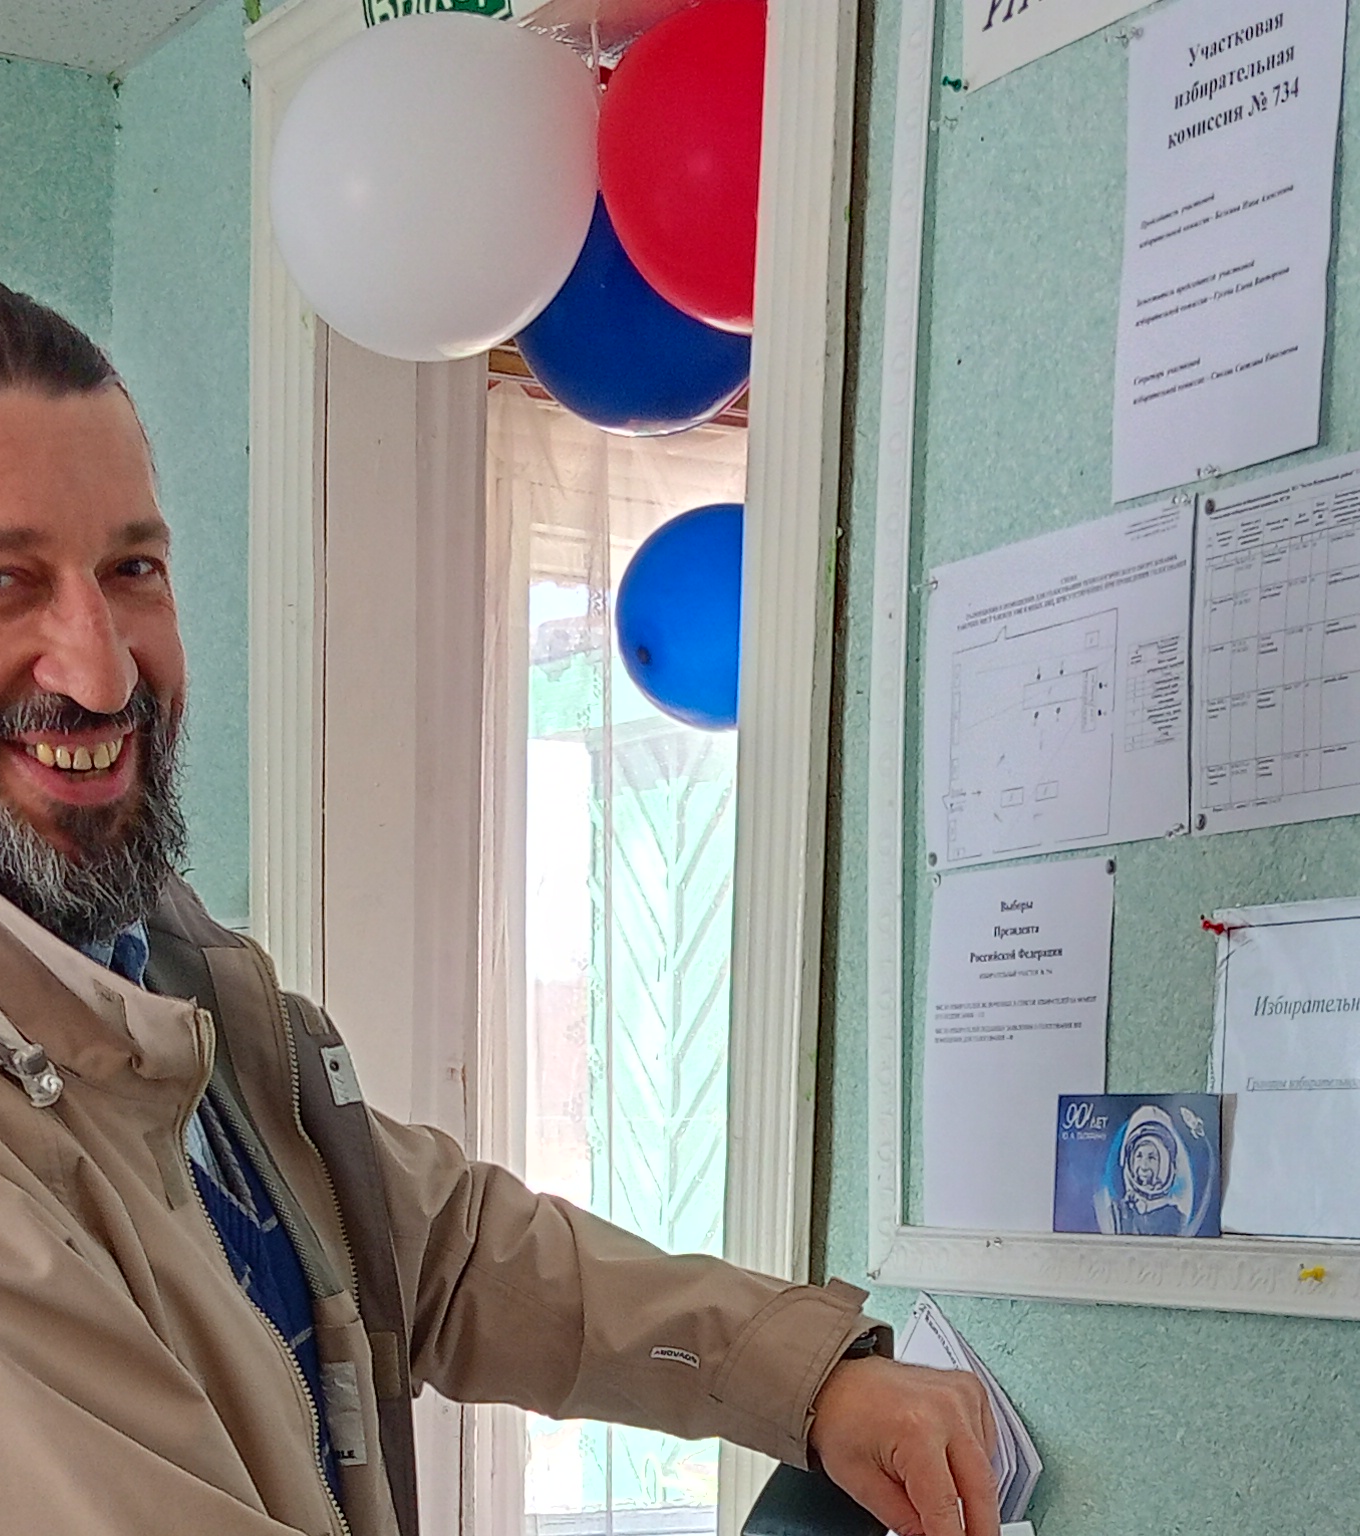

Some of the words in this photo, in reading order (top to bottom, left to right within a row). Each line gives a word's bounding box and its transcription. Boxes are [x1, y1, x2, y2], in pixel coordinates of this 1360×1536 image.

[1189, 12, 1284, 67] Участковая
[1174, 45, 1295, 110] избирательная
[1168, 105, 1243, 150] комиссия
[1248, 91, 1268, 117] №
[1273, 76, 1299, 107] 734
[994, 925, 1039, 939] Президента
[1001, 900, 1033, 913] Выборы
